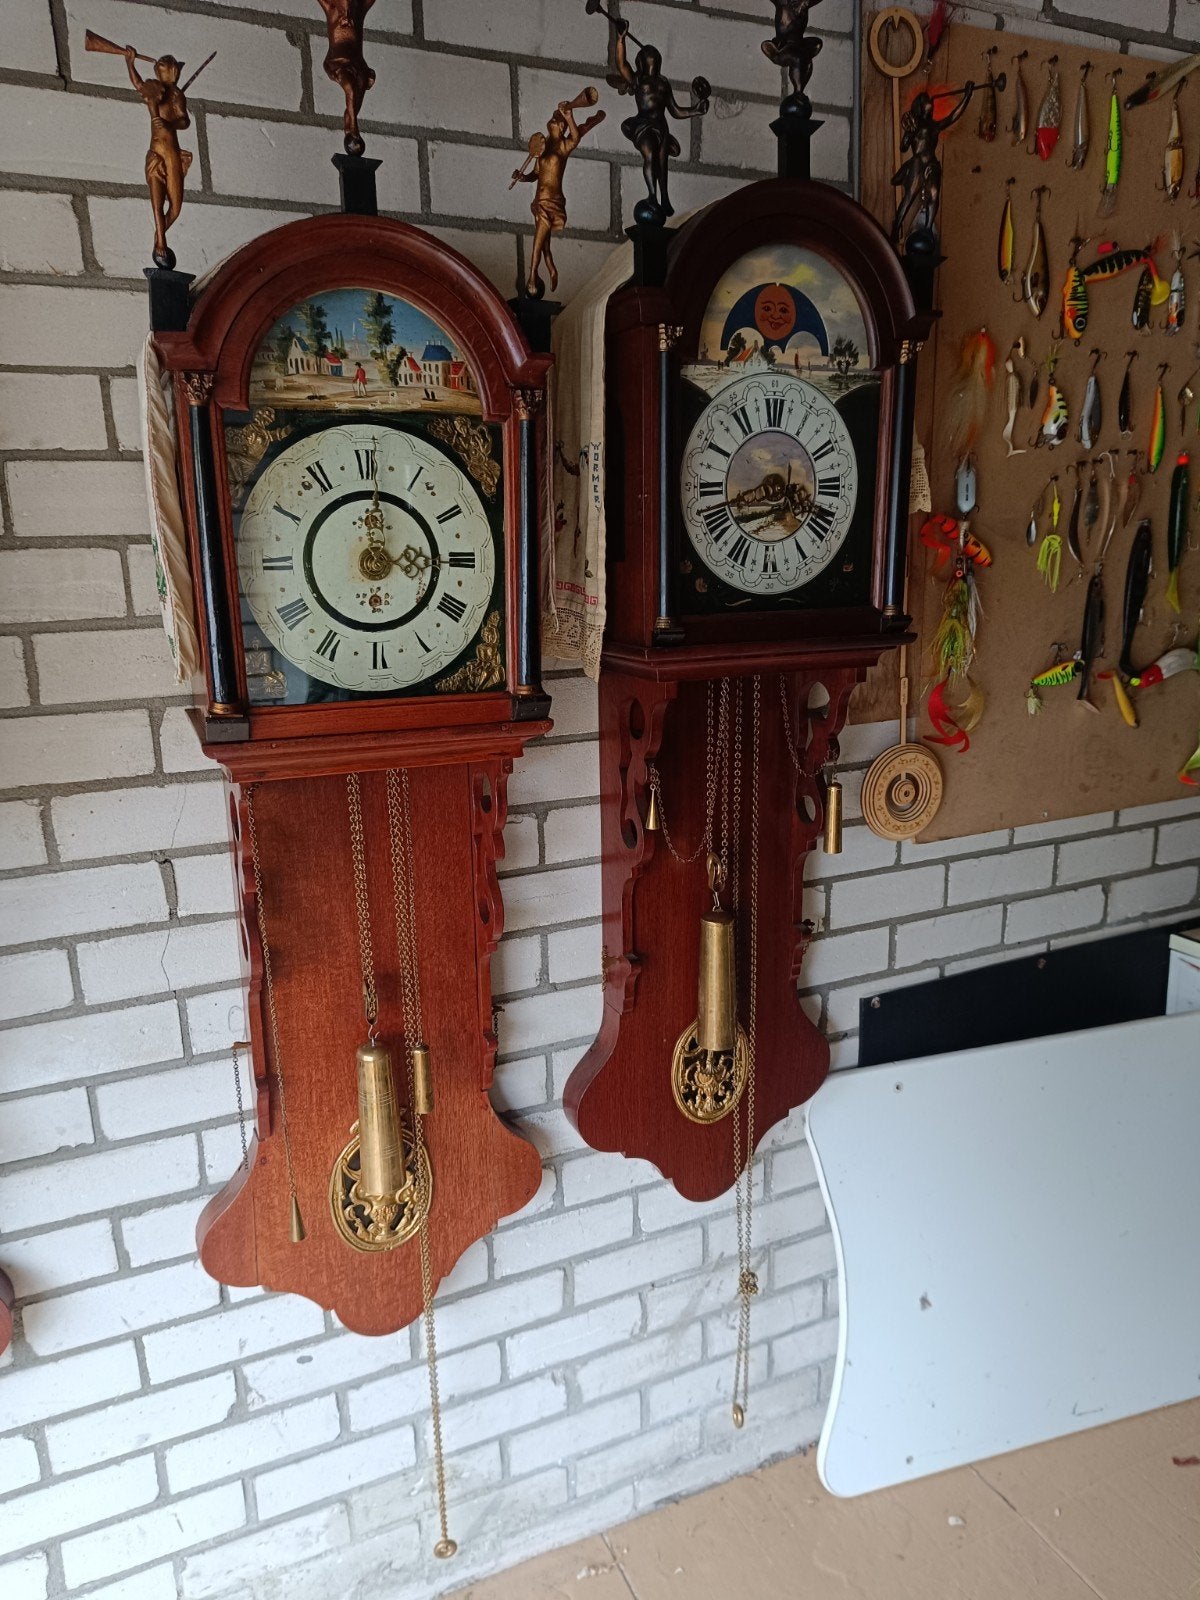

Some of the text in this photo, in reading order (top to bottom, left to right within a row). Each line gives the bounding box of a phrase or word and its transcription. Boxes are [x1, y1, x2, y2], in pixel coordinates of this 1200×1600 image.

[729, 393, 739, 401] 55
[732, 405, 754, 436] XI
[765, 398, 785, 427] XII
[812, 439, 835, 461] II
[818, 476, 840, 498] III
[434, 503, 463, 525] II
[448, 551, 476, 569] III
[724, 570, 735, 579] 35
[804, 567, 813, 576] 25
[765, 581, 774, 590] 30
[436, 592, 468, 623] IIII
